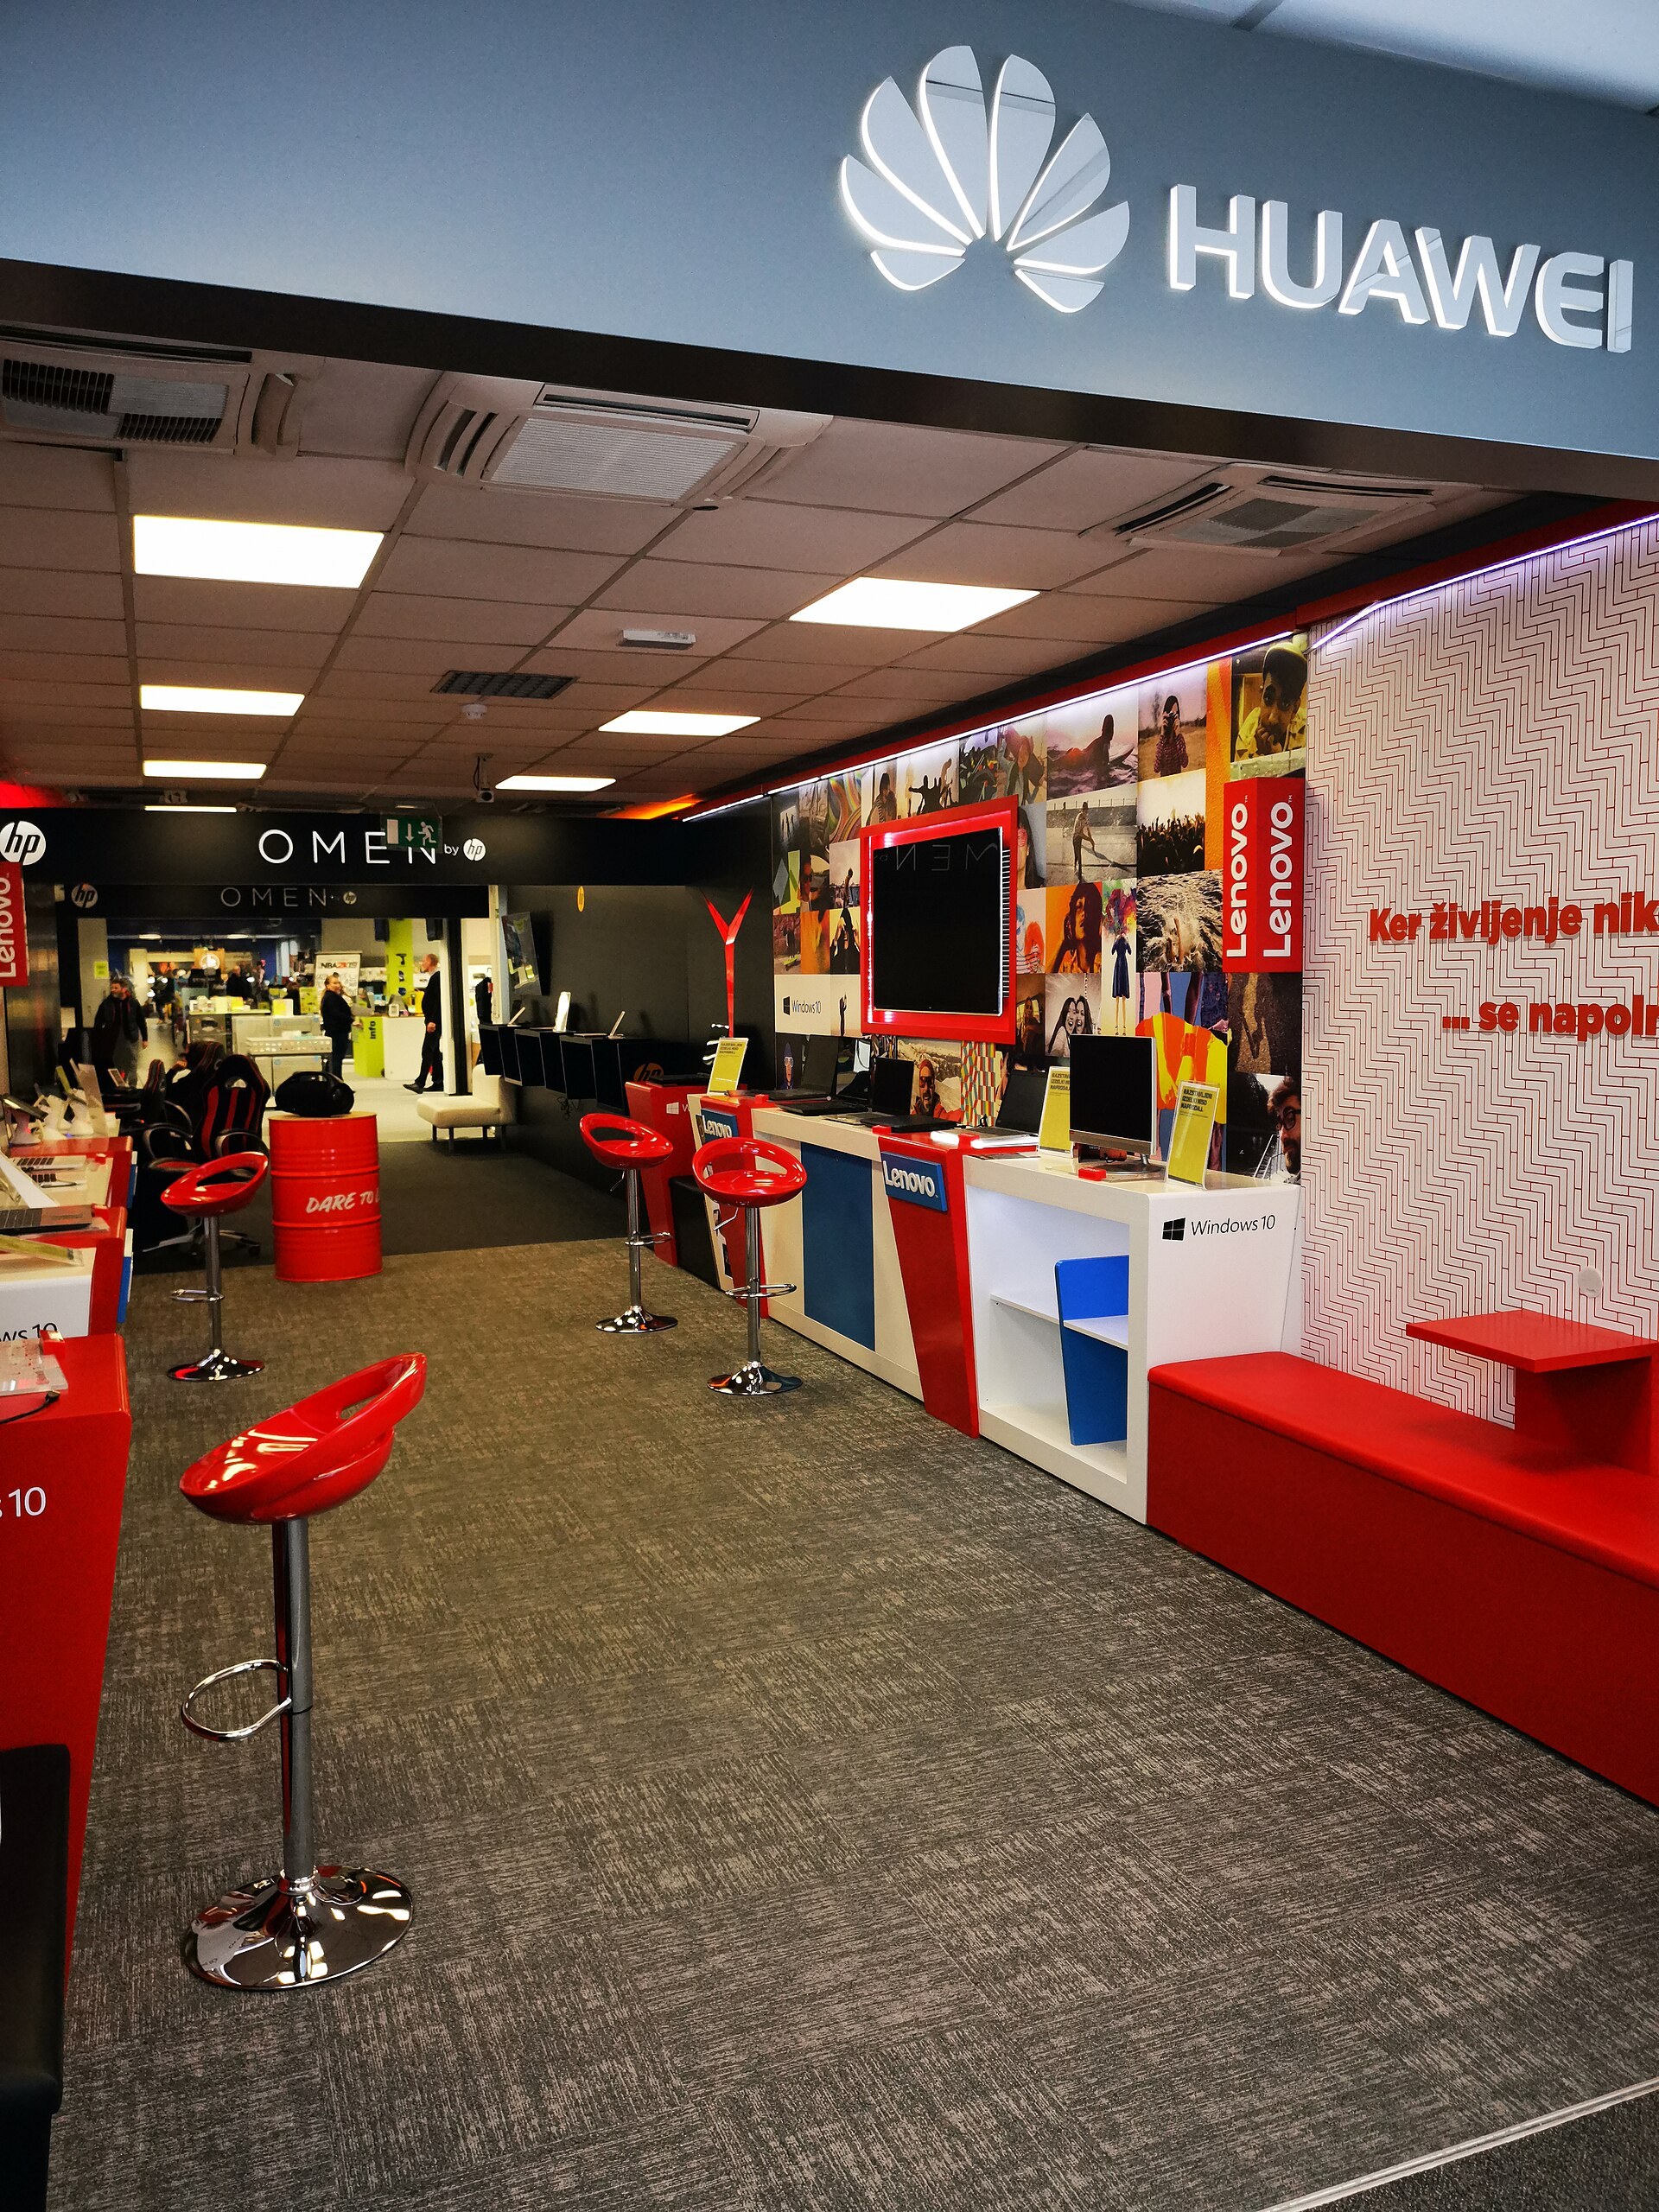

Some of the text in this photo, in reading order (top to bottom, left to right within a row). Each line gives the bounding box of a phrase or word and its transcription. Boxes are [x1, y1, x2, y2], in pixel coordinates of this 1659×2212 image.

[1169, 184, 1635, 354] HUAWEI
[0, 821, 47, 866] hp
[444, 843, 460, 855] by
[463, 838, 486, 861] hp
[1226, 803, 1249, 957] Lenovo
[1263, 802, 1294, 957] Lenovo
[71, 883, 99, 908] hp
[220, 887, 357, 907] OMEN hp
[0, 877, 16, 978] Lenovo
[1370, 890, 1659, 946] Ker življenje nik
[791, 1000, 815, 1014] Windows
[702, 1115, 733, 1139] Lenovo
[882, 1160, 936, 1198] Lenovo
[306, 1192, 357, 1213] DARE
[359, 1191, 373, 1205] TO
[1191, 1214, 1276, 1236] Windows 10
[8, 1486, 47, 1517] 10
